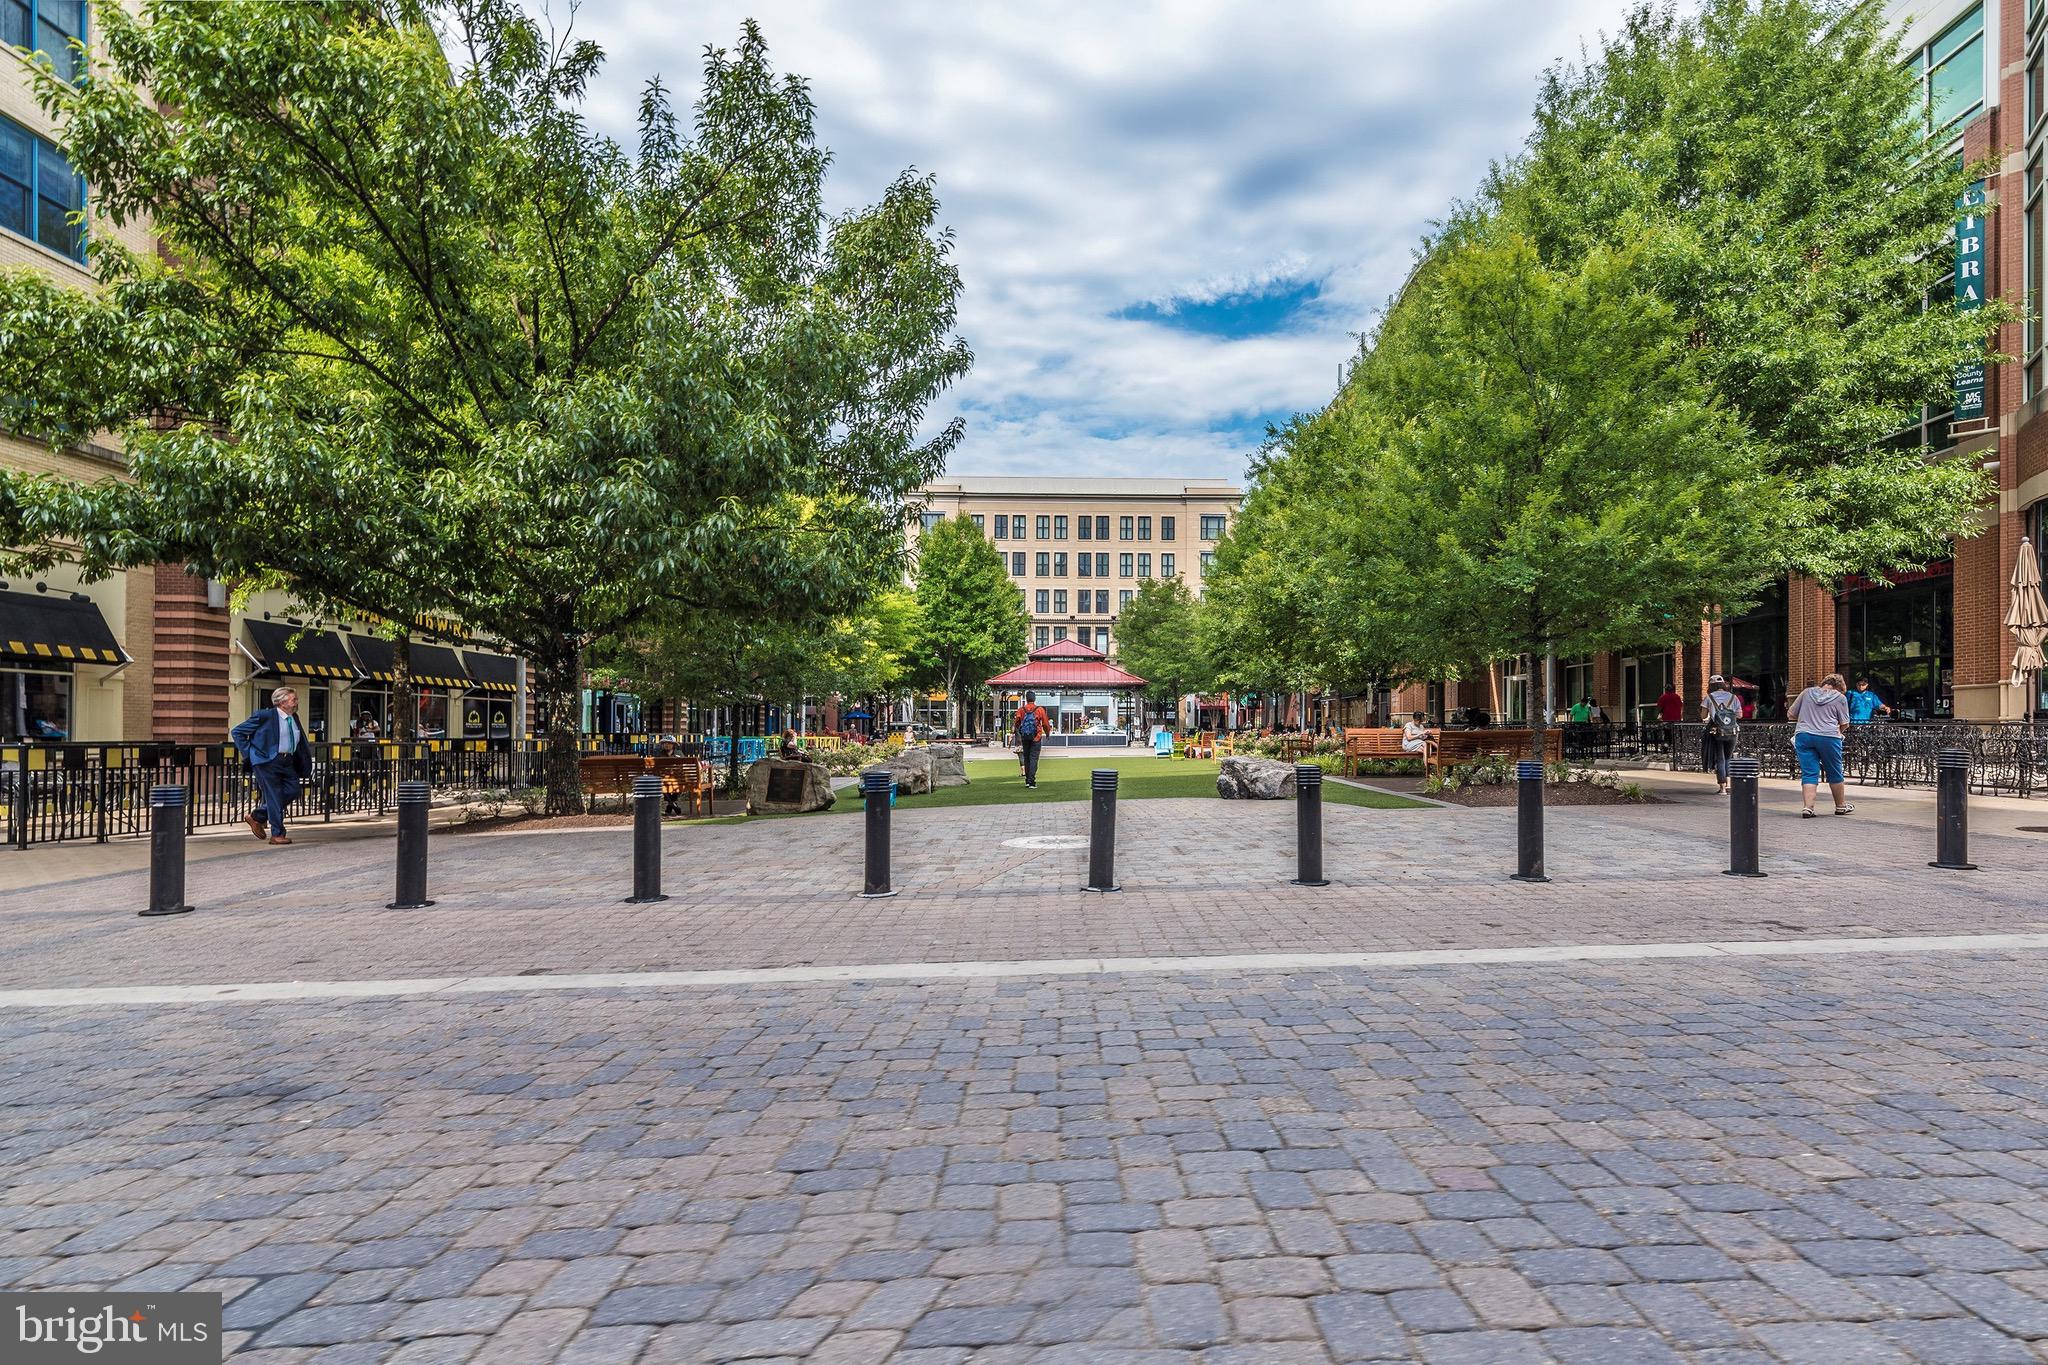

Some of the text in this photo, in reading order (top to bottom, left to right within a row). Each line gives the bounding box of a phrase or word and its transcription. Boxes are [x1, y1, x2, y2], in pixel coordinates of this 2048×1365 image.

[1956, 370, 1983, 379] County
[1956, 377, 1984, 386] Learns
[1892, 634, 1902, 644] 29
